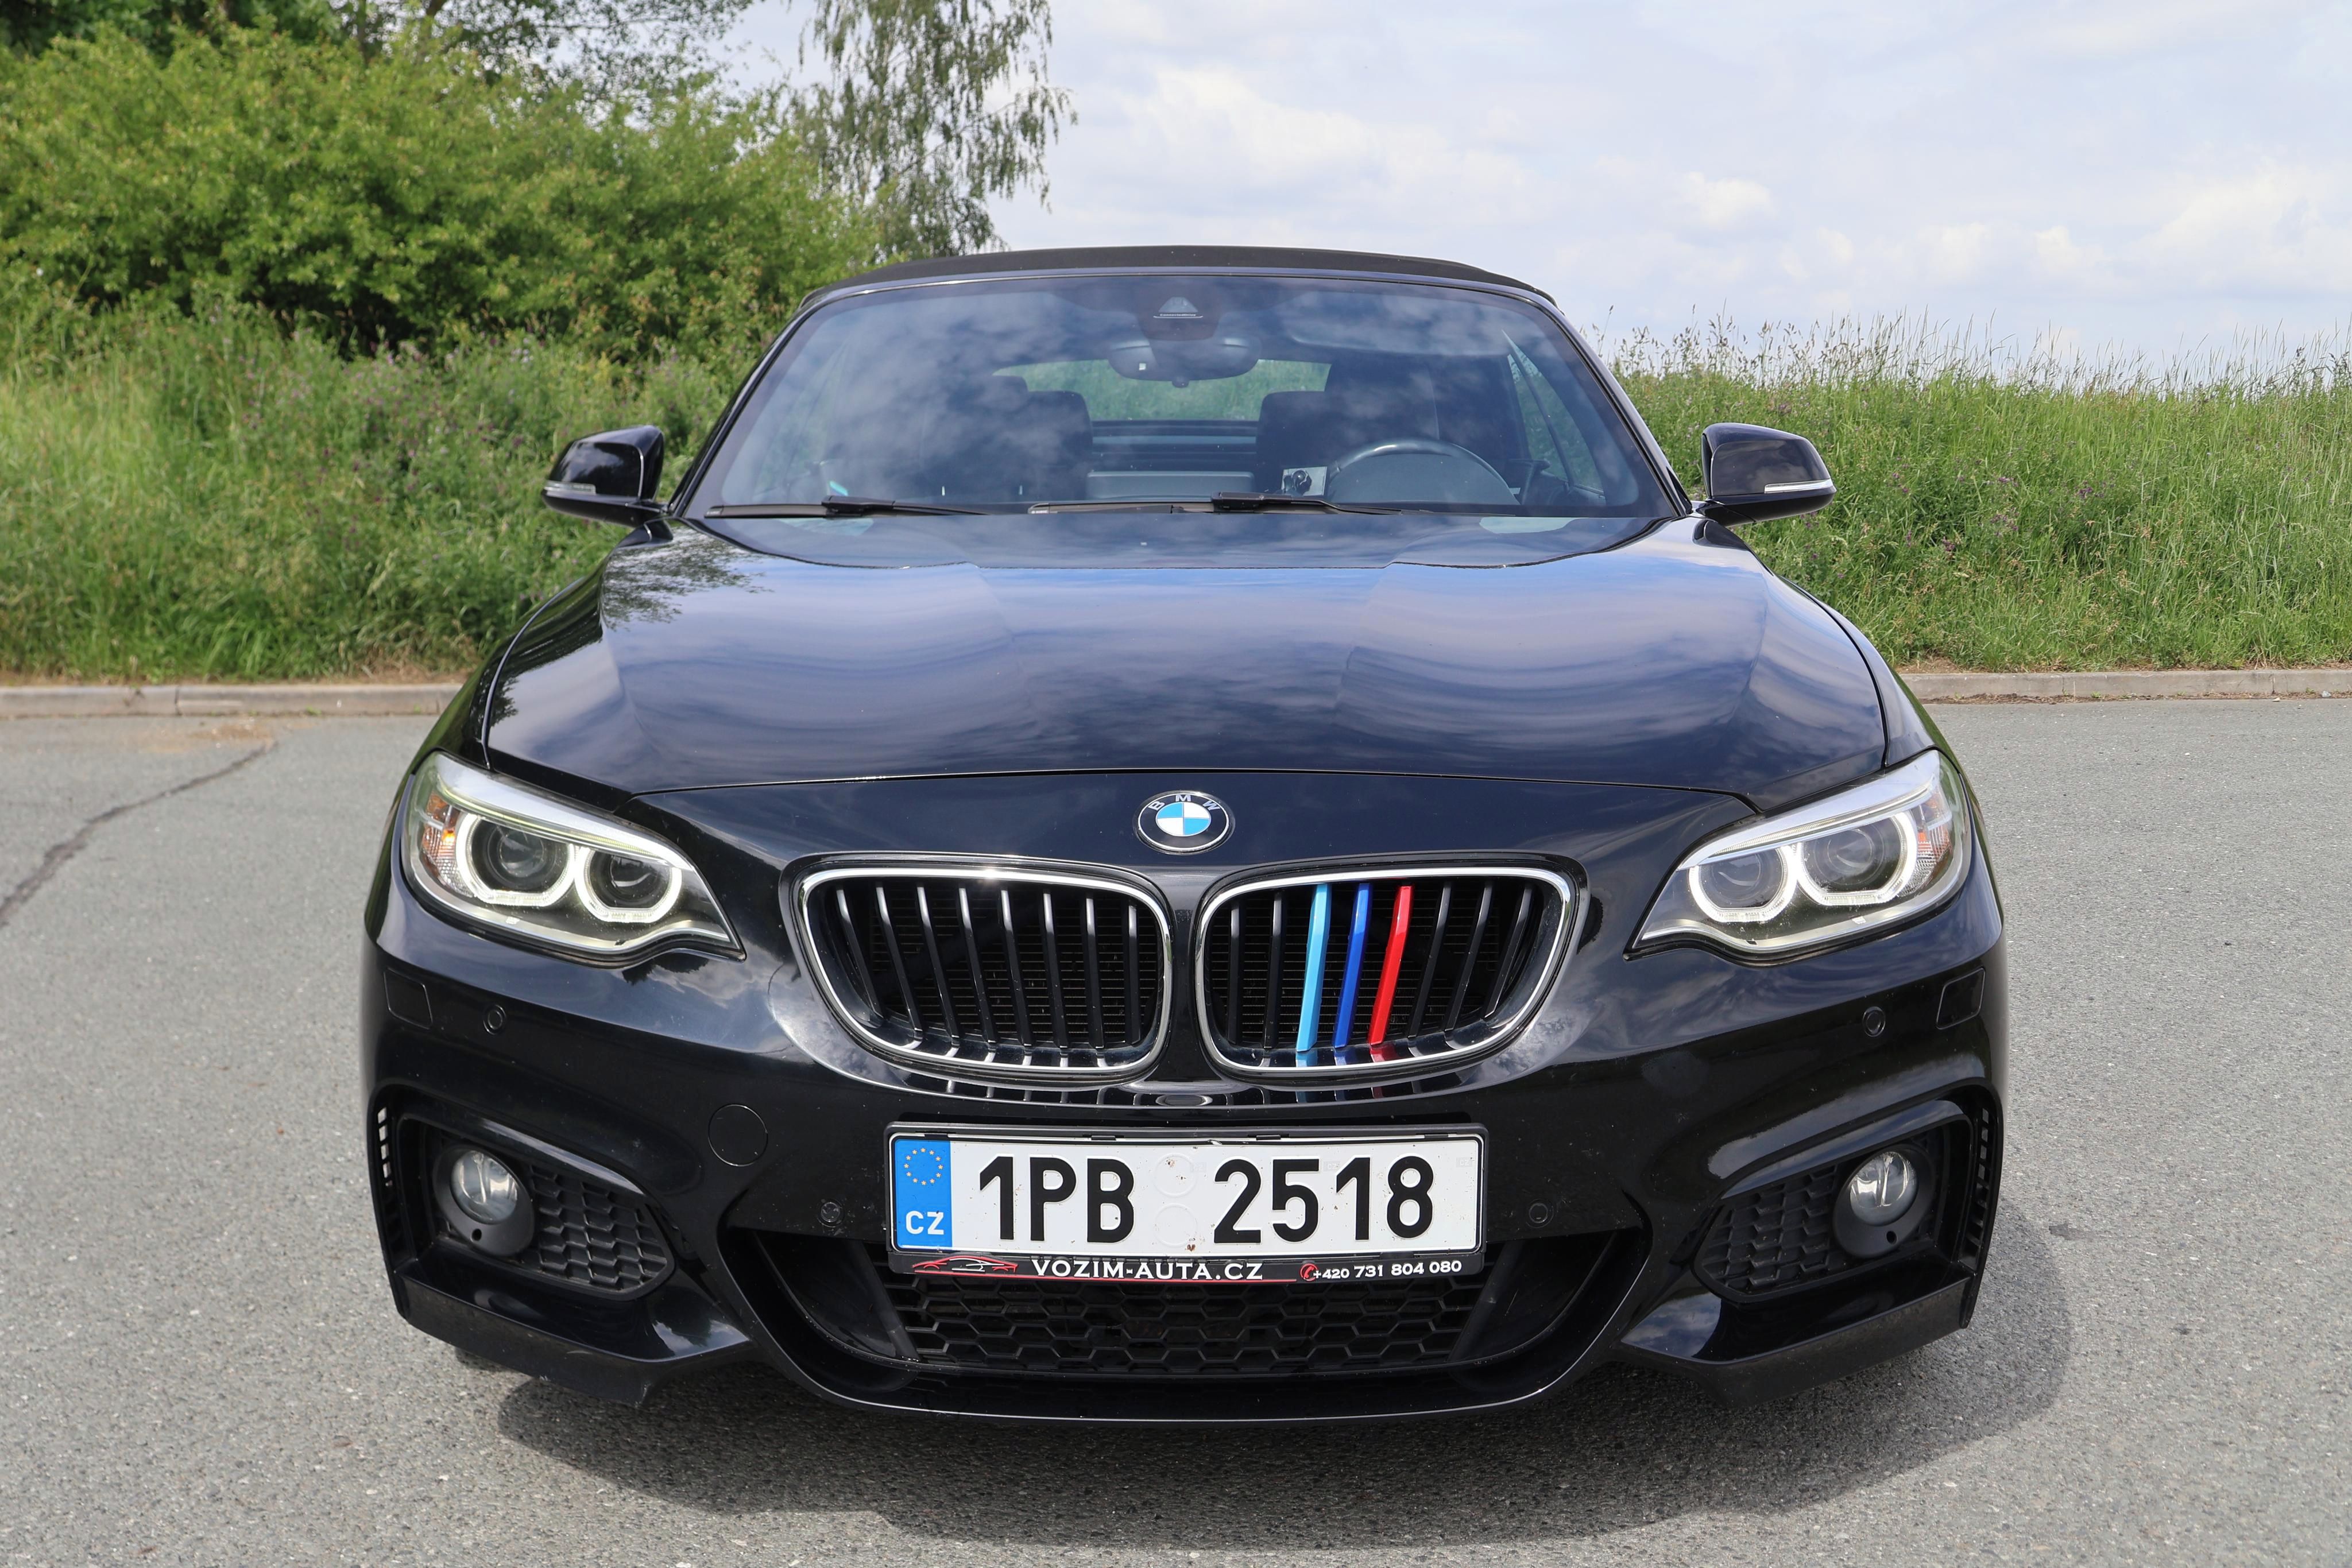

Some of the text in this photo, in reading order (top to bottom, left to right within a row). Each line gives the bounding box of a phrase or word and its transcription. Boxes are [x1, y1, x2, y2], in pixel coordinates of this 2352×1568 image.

[1148, 795, 1220, 811] BMW
[980, 1156, 1434, 1244] 1PB 2518
[906, 1210, 944, 1234] CZ
[1031, 1259, 1263, 1280] VOZIM-AUTA.CZ
[1313, 1260, 1462, 1279] +420 731 804 080
